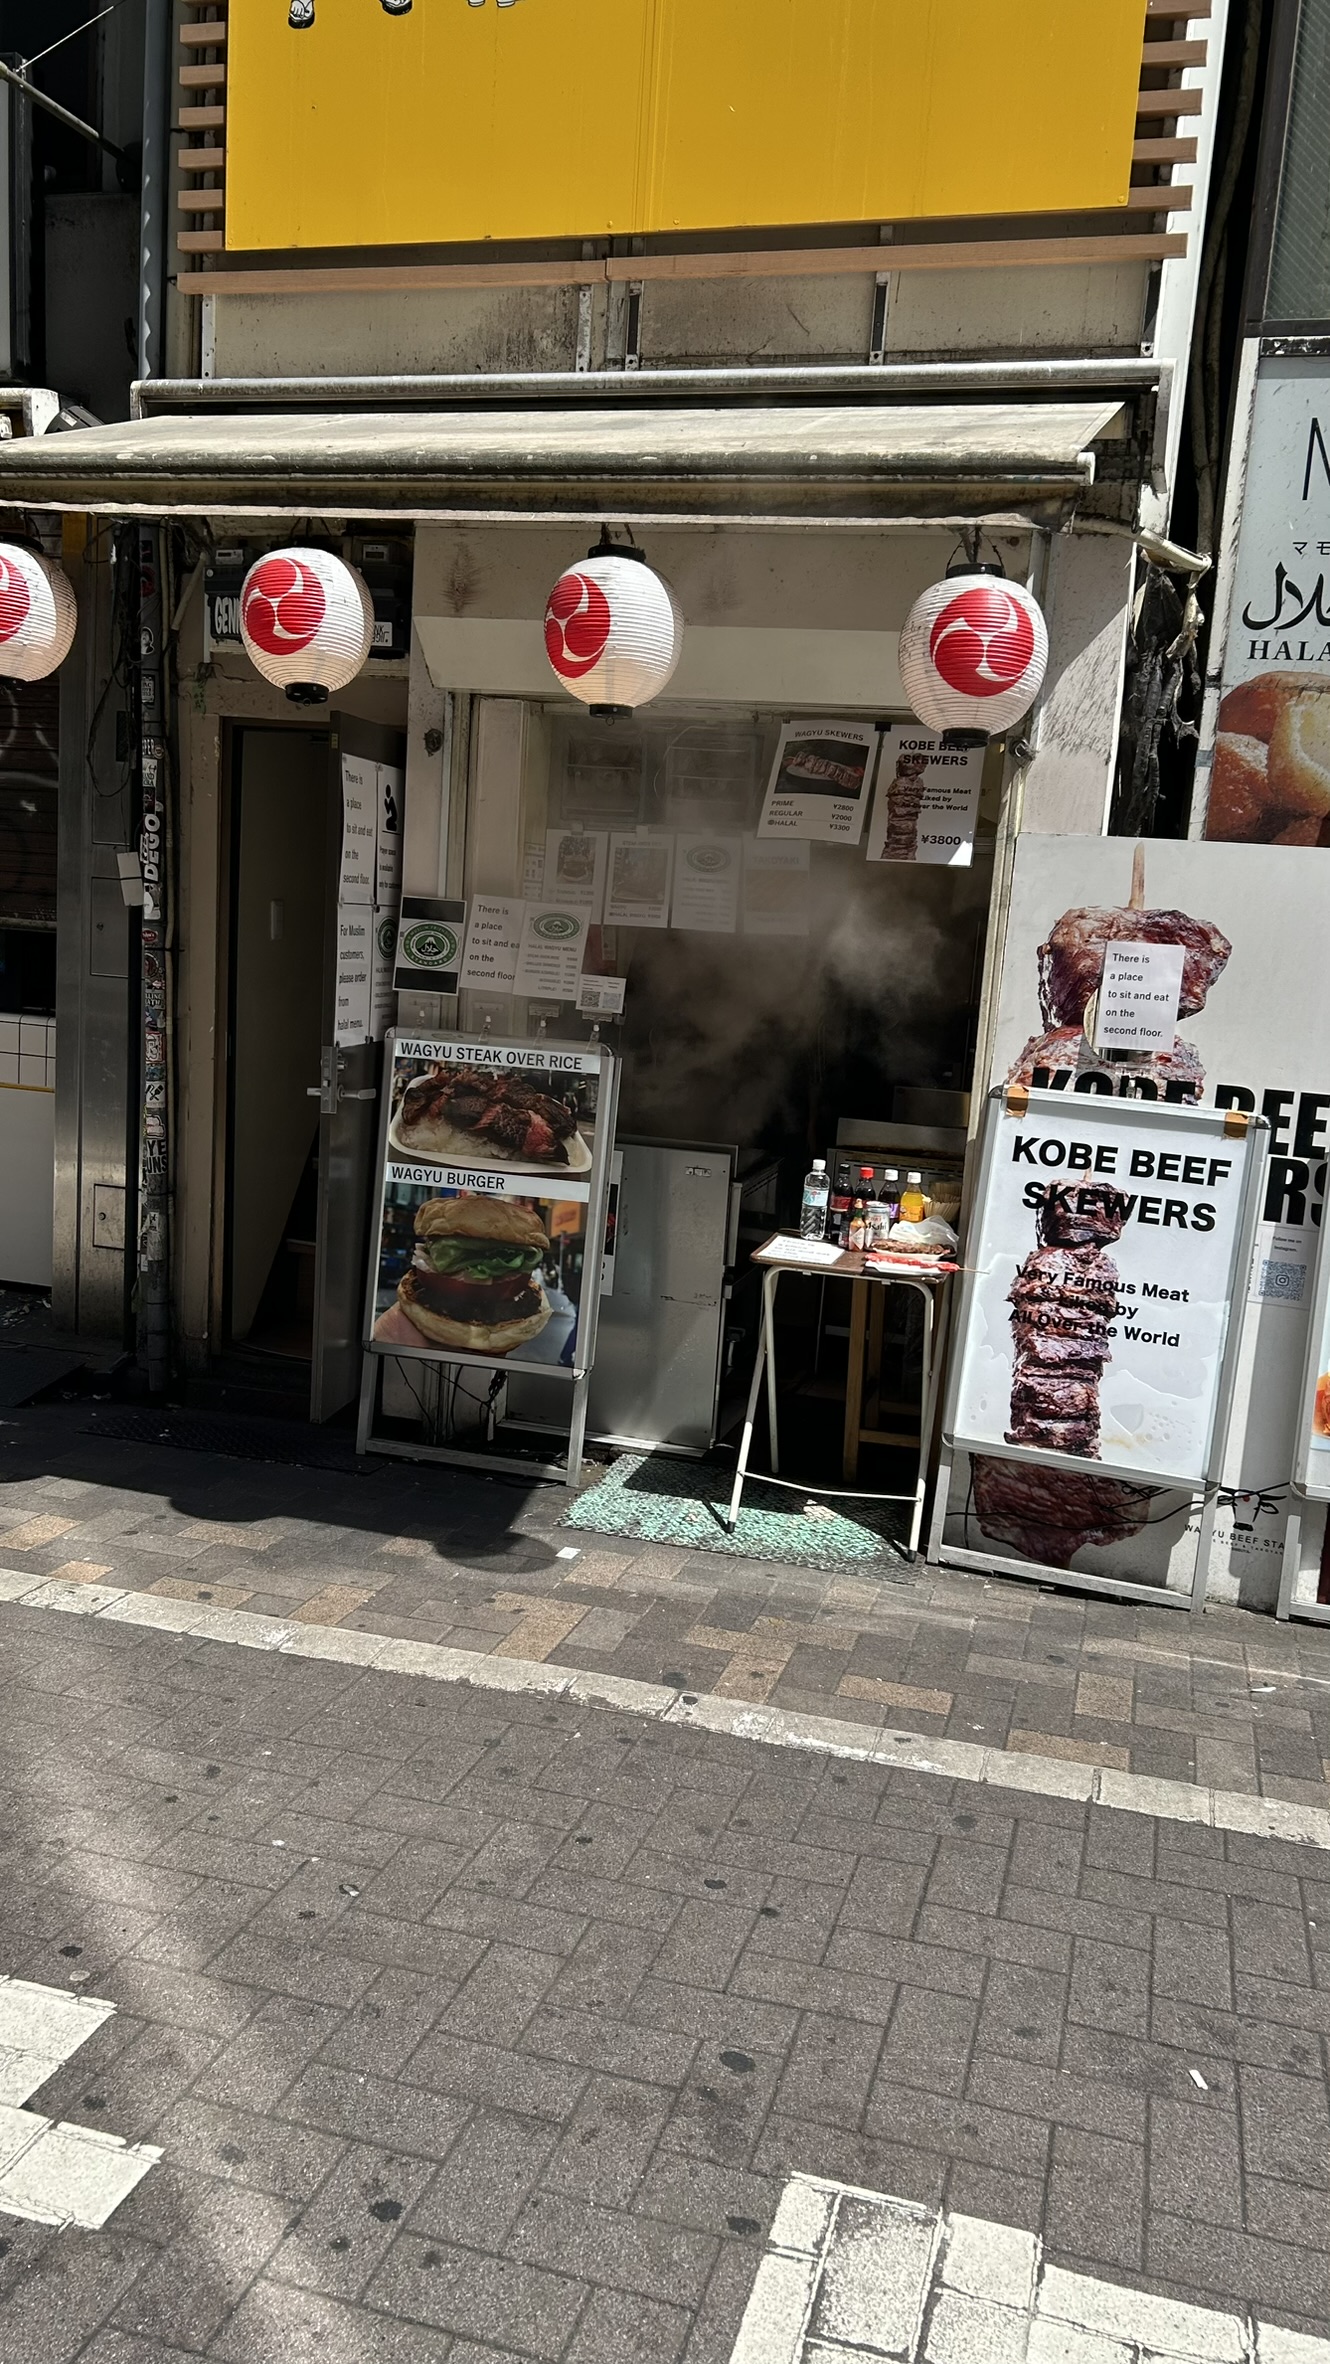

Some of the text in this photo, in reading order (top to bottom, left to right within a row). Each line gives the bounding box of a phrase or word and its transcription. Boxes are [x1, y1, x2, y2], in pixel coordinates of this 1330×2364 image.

[795, 729, 864, 742] WAGYU SKEWERS
[899, 740, 936, 751] KOBE
[903, 755, 968, 766] SKEWERS
[345, 770, 359, 785] There
[350, 797, 362, 811] place
[833, 803, 854, 812] ¥2800
[946, 804, 968, 812] World
[831, 813, 852, 822] ¥2000
[358, 825, 366, 837] and
[829, 823, 850, 832] ¥3300
[921, 834, 961, 846] ¥3800
[351, 849, 359, 861] the
[343, 873, 359, 885] second
[478, 904, 509, 916] There is
[340, 925, 365, 937] For Muslim
[481, 921, 503, 932] place
[472, 937, 480, 946] to
[481, 938, 492, 947] sit
[494, 940, 509, 949] and
[469, 953, 494, 963] on the
[1113, 953, 1150, 964] There is
[339, 972, 366, 985] please order
[467, 968, 495, 979] second
[1118, 972, 1143, 982] place
[339, 996, 349, 1007] from
[1108, 990, 1169, 1002] to sit and eat
[1105, 1009, 1135, 1018] on the
[338, 1019, 349, 1031] halal
[1103, 1026, 1163, 1037] second floor.
[401, 1042, 583, 1070] WAGYU STEAK OVER RICE
[1012, 1135, 1232, 1187] KOBE BEEF
[391, 1166, 505, 1190] WAGYU BURGER
[1022, 1181, 1217, 1232] SKEWERS
[1016, 1264, 1190, 1302] Very Famous Meat
[1116, 1300, 1139, 1320] by
[1038, 1313, 1082, 1332] Over
[1088, 1320, 1118, 1338] the
[1124, 1326, 1180, 1347] World
[1230, 1533, 1258, 1545] BEEF
